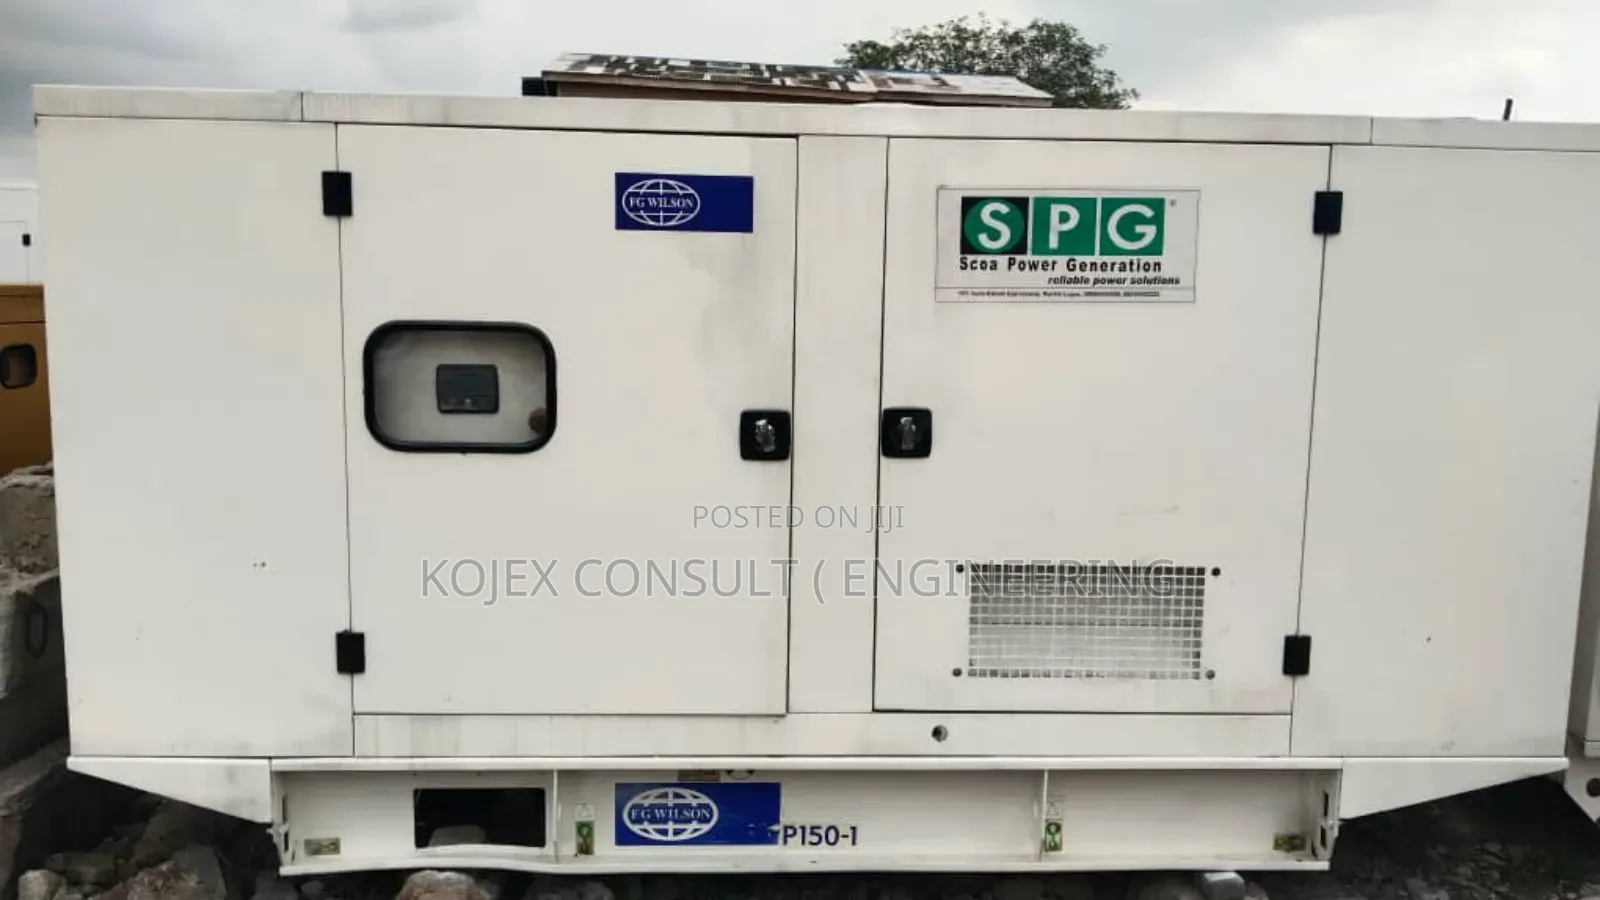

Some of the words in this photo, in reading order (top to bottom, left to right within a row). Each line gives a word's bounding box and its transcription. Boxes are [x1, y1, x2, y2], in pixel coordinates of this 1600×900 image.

[630, 196, 645, 207] FG
[647, 197, 693, 207] WILSON
[978, 202, 1157, 250] SPG
[959, 257, 998, 271] Scoa
[1007, 257, 1057, 272] Power
[1066, 258, 1162, 273] Generation
[1048, 275, 1089, 285] reliable
[1092, 277, 1127, 286] power
[1130, 275, 1180, 285] solutions
[631, 808, 650, 819] FG
[655, 808, 710, 820] WILSON
[782, 825, 857, 846] P150-1
